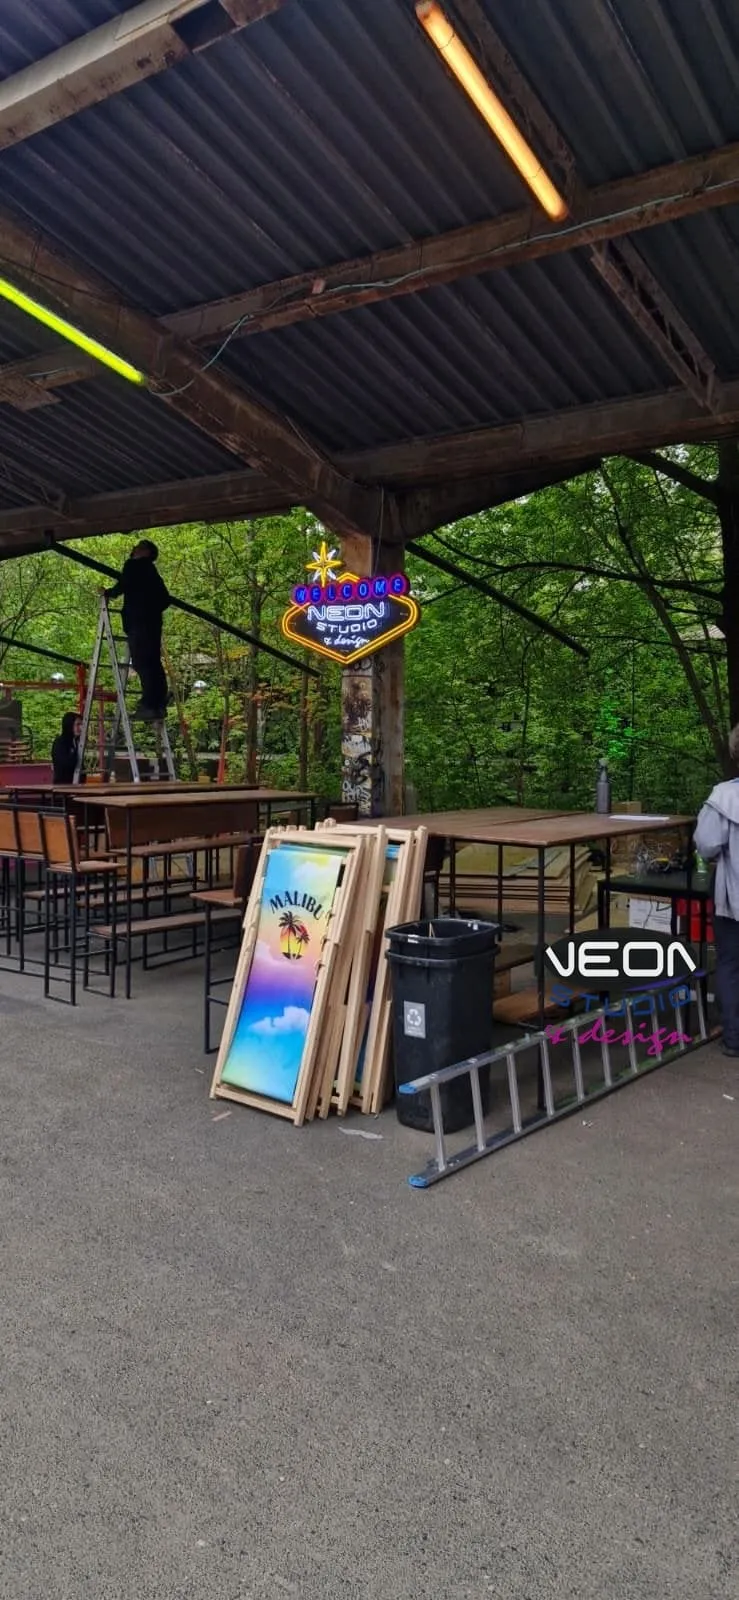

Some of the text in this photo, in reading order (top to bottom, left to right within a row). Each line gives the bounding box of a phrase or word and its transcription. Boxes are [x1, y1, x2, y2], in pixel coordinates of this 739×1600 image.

[296, 578, 401, 604] WELCOME
[307, 601, 385, 621] NEON
[316, 619, 378, 634] STUDIO
[334, 634, 370, 648] design
[270, 890, 324, 921] MALIBU
